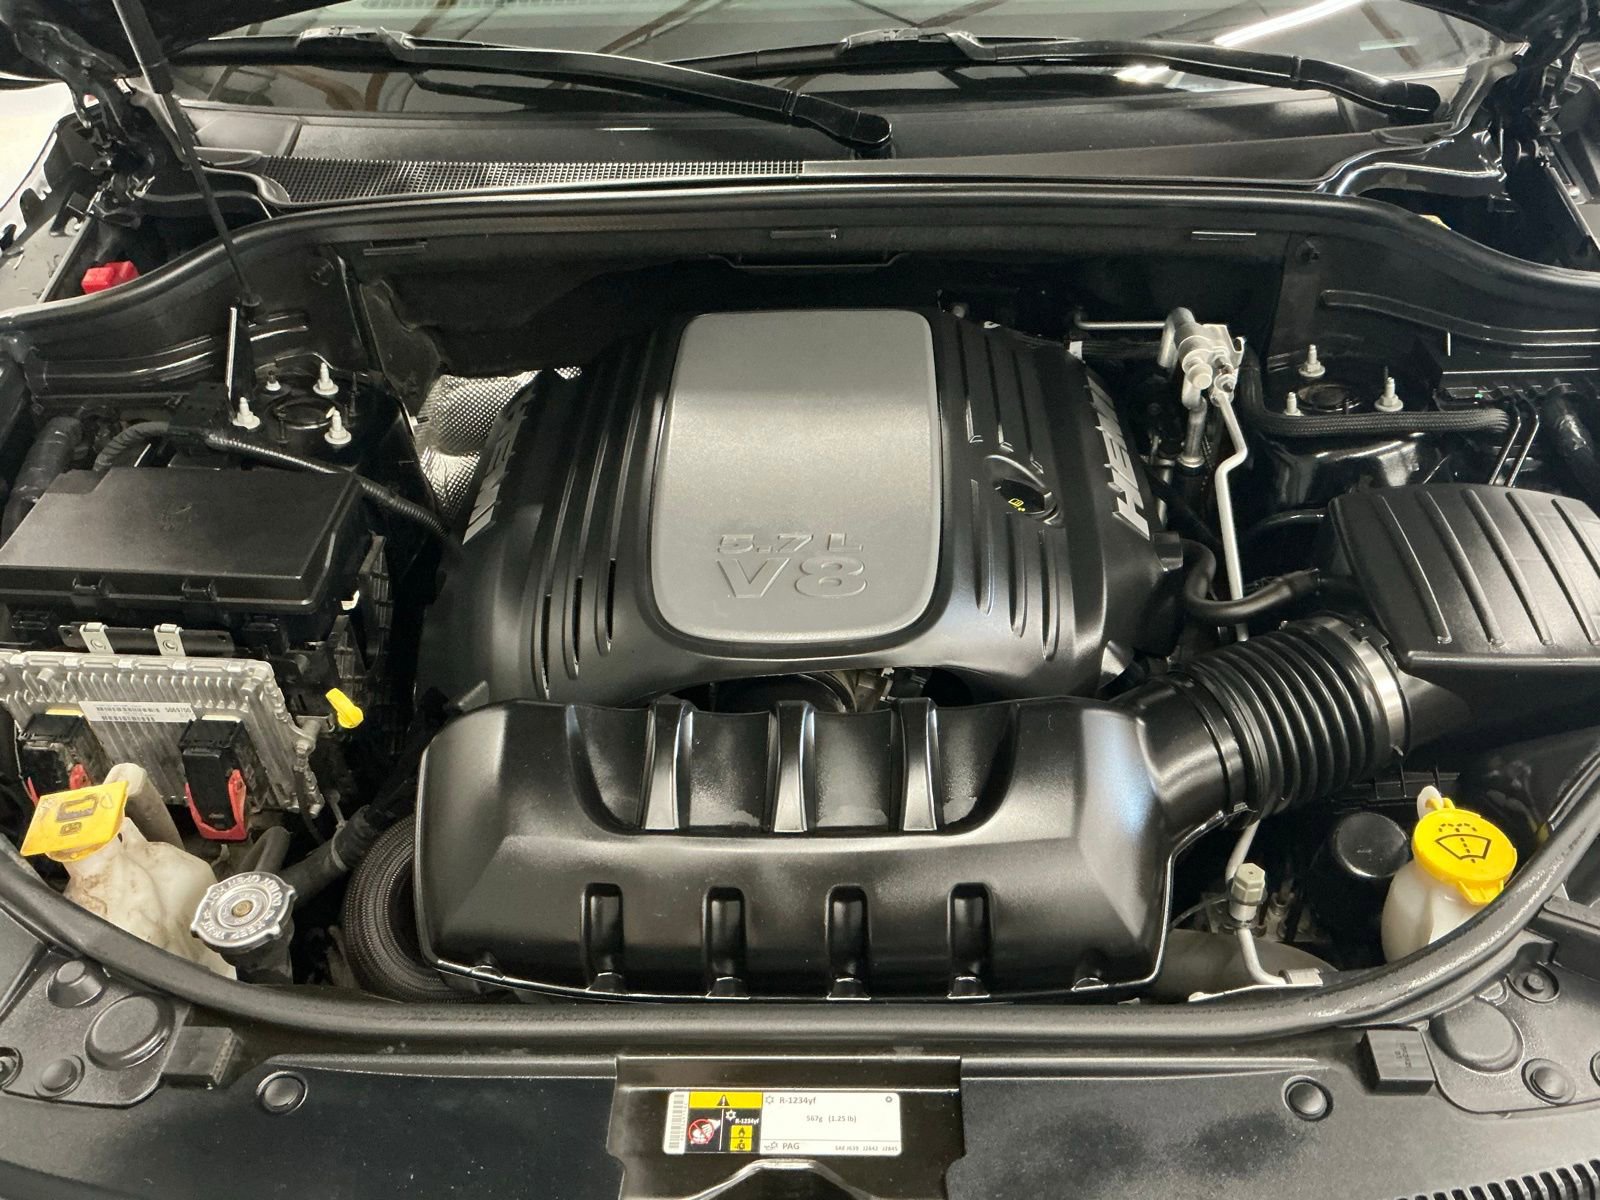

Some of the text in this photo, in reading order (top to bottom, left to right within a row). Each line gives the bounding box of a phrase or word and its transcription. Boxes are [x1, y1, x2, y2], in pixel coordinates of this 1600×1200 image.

[716, 556, 868, 598] V8
[779, 1095, 817, 1105] R-1234yf
[806, 1114, 857, 1123] 567g (1.25 lb)
[782, 1142, 800, 1151] PAG
